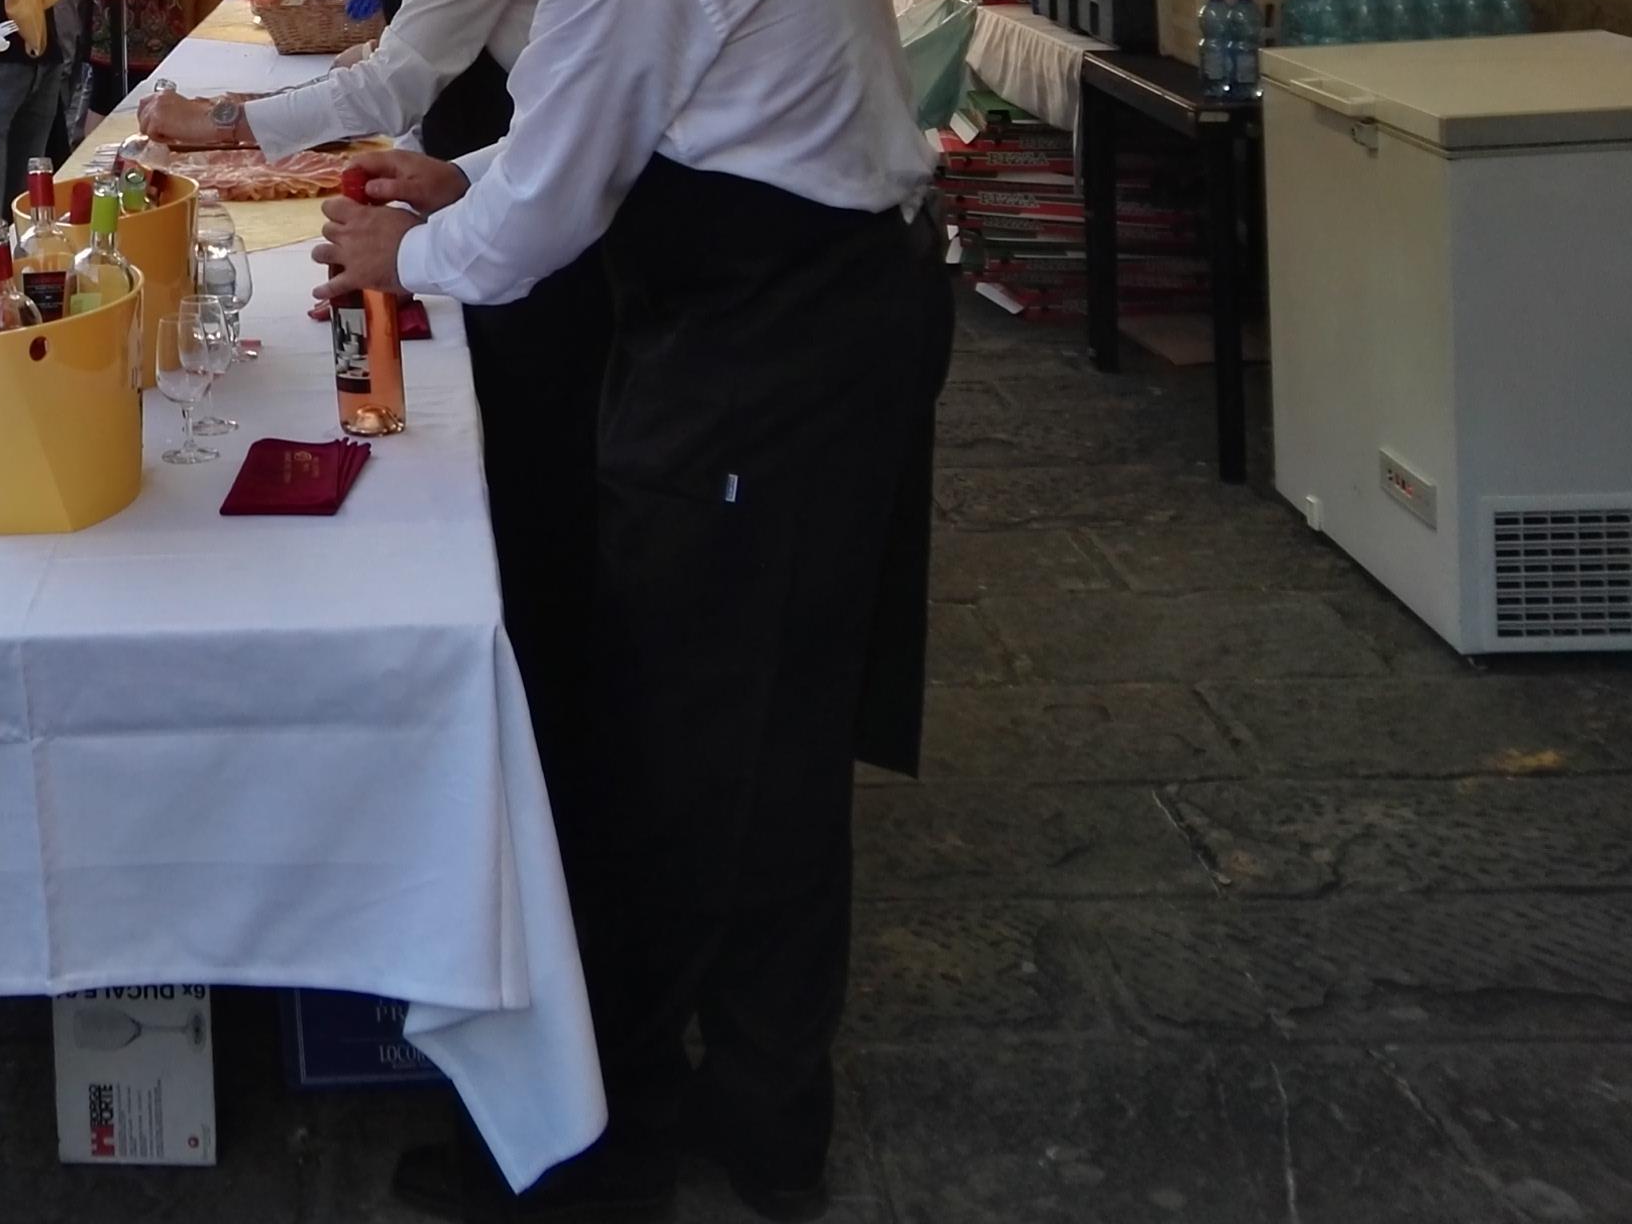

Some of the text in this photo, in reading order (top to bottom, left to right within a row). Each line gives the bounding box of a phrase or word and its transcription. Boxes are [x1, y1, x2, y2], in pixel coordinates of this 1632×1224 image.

[987, 152, 1049, 166] PIZZA
[978, 192, 1040, 208] PIZZA
[181, 984, 206, 999] 6x
